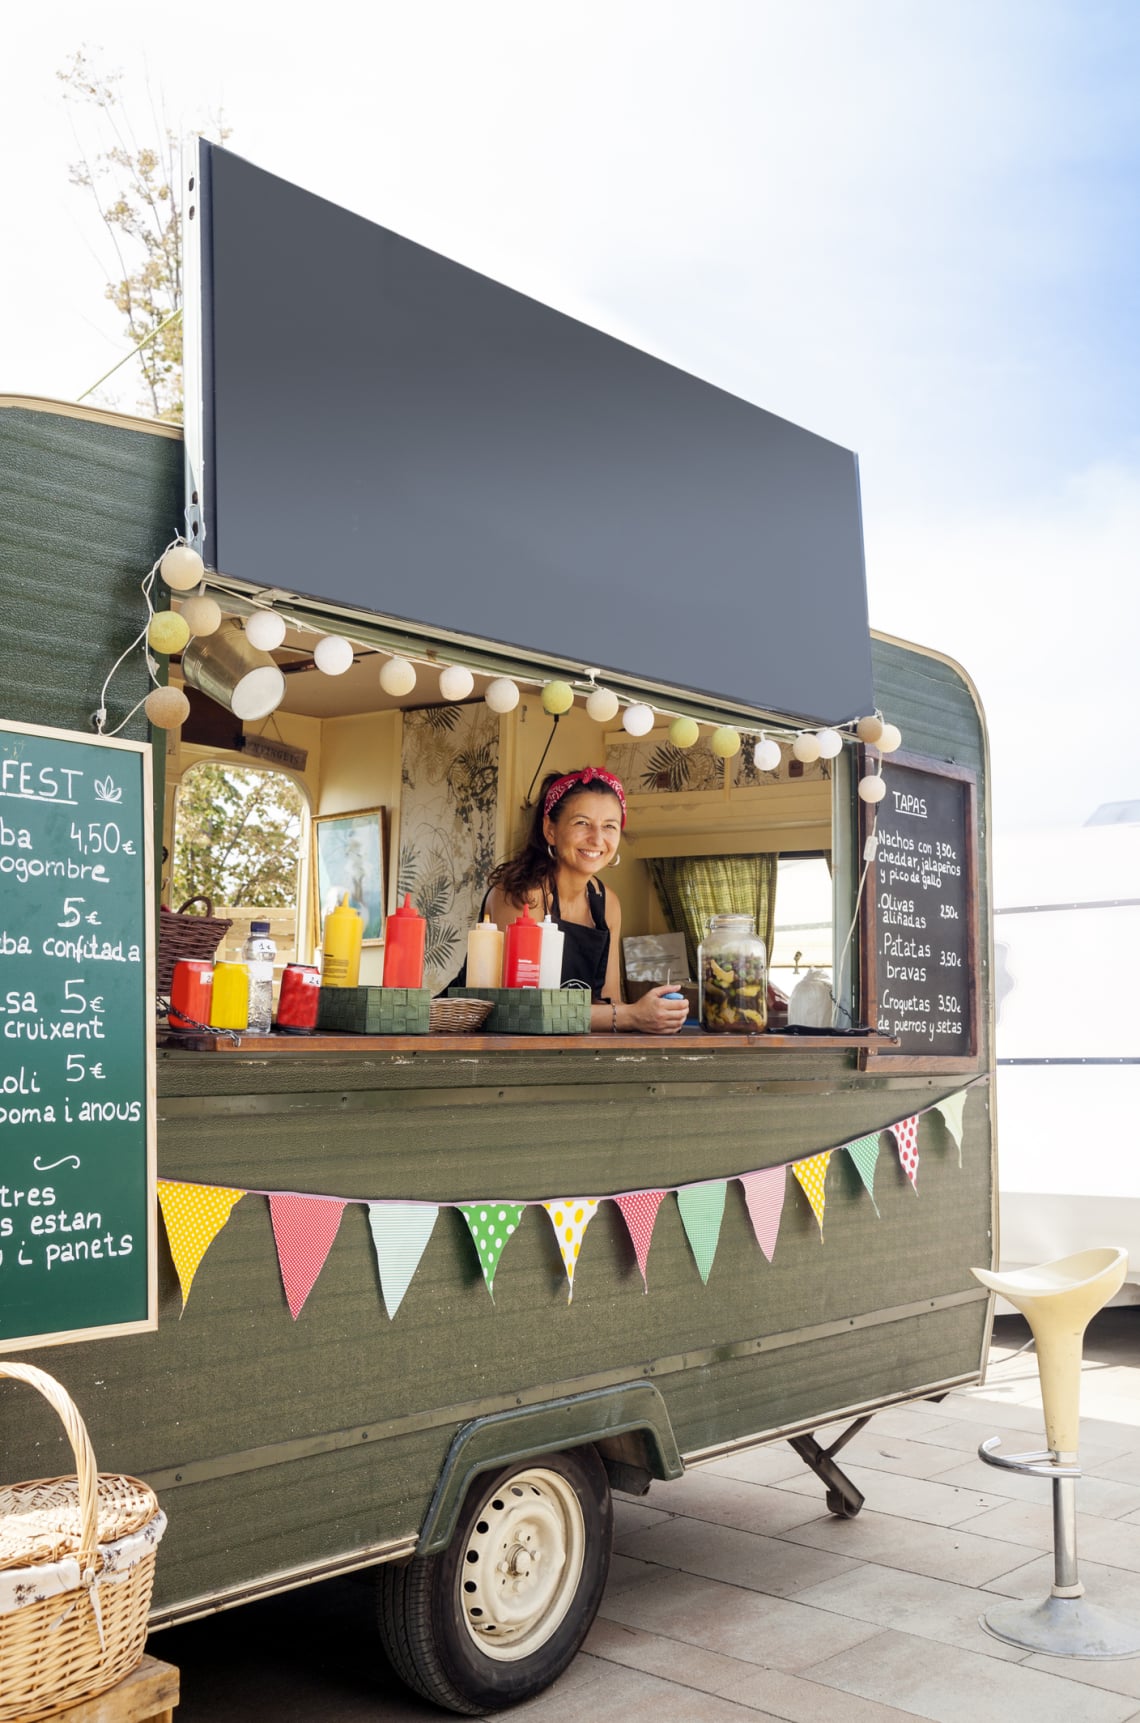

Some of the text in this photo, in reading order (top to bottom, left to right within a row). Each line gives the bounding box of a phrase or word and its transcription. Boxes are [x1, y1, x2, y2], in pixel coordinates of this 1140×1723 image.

[2, 760, 83, 799] FEST
[892, 791, 927, 815] TAPAS
[70, 822, 136, 855] 4,50€
[878, 830, 956, 860] Nachos con 3,50€
[880, 867, 942, 889] y pico de gallo
[920, 857, 961, 876] jalapeños
[882, 910, 927, 929] aliñadas
[43, 934, 141, 963] confitada
[886, 961, 927, 982] bravas
[4, 1018, 105, 1040] cruixent
[878, 1015, 962, 1042] de puerros y setas
[65, 1097, 73, 1123] i
[79, 1101, 142, 1122] anous
[30, 1210, 102, 1235] estan
[18, 1241, 33, 1266] i
[46, 1232, 133, 1270] panets
